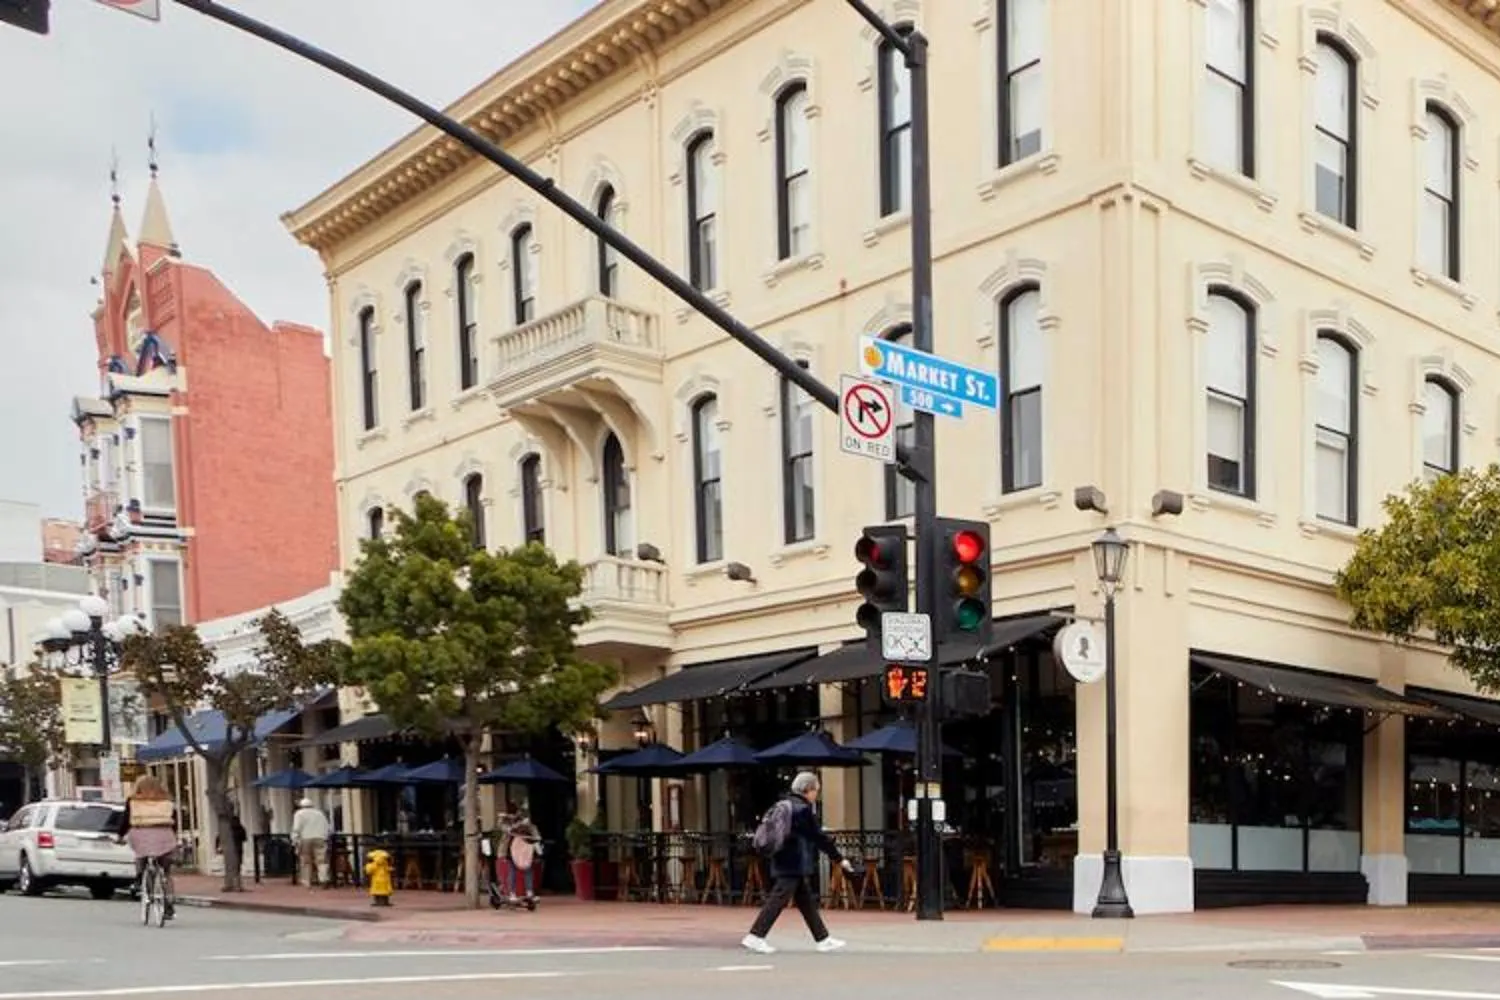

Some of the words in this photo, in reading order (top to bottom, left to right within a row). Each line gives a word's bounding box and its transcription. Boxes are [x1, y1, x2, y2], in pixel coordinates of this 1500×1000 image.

[886, 351, 959, 392] MARKET
[965, 374, 990, 401] ST.
[910, 388, 934, 409] 500
[845, 437, 861, 450] ON
[867, 441, 890, 457] RED
